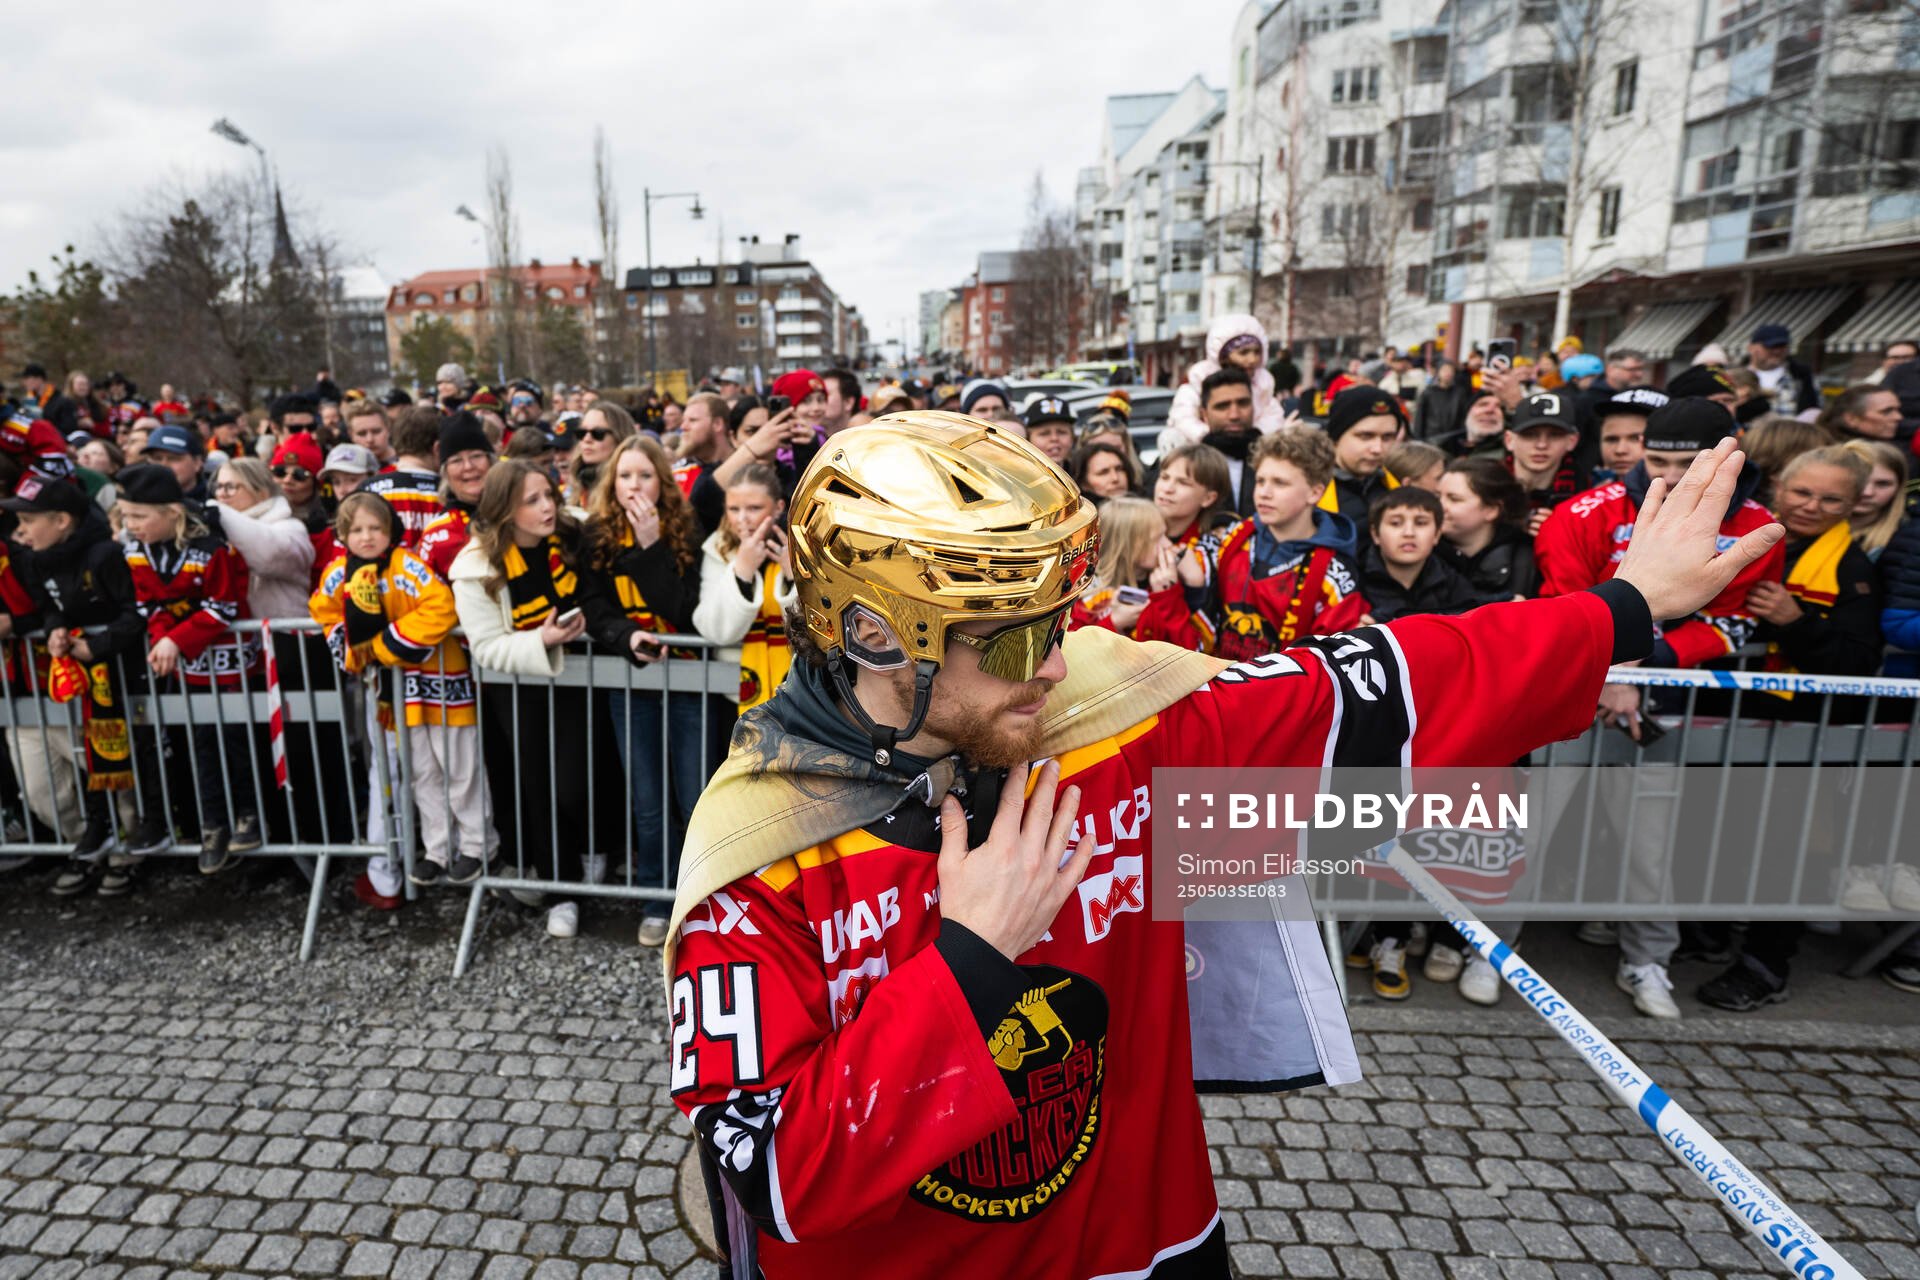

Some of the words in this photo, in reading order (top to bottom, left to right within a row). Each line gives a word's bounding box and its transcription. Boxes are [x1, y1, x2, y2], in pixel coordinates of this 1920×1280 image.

[1327, 557, 1356, 594] SAB
[670, 962, 764, 1098] 24
[1507, 967, 1566, 1017] POLIS
[1553, 1014, 1641, 1089] AVSPÄRRAT
[1664, 1128, 1772, 1226] AVSPÄRRAT
[1723, 1158, 1751, 1183] CROSS
[1750, 1184, 1769, 1200] NOT
[1766, 1199, 1782, 1212] DO
[1783, 1216, 1817, 1245] POLICE
[1763, 1223, 1835, 1280] OLIS
